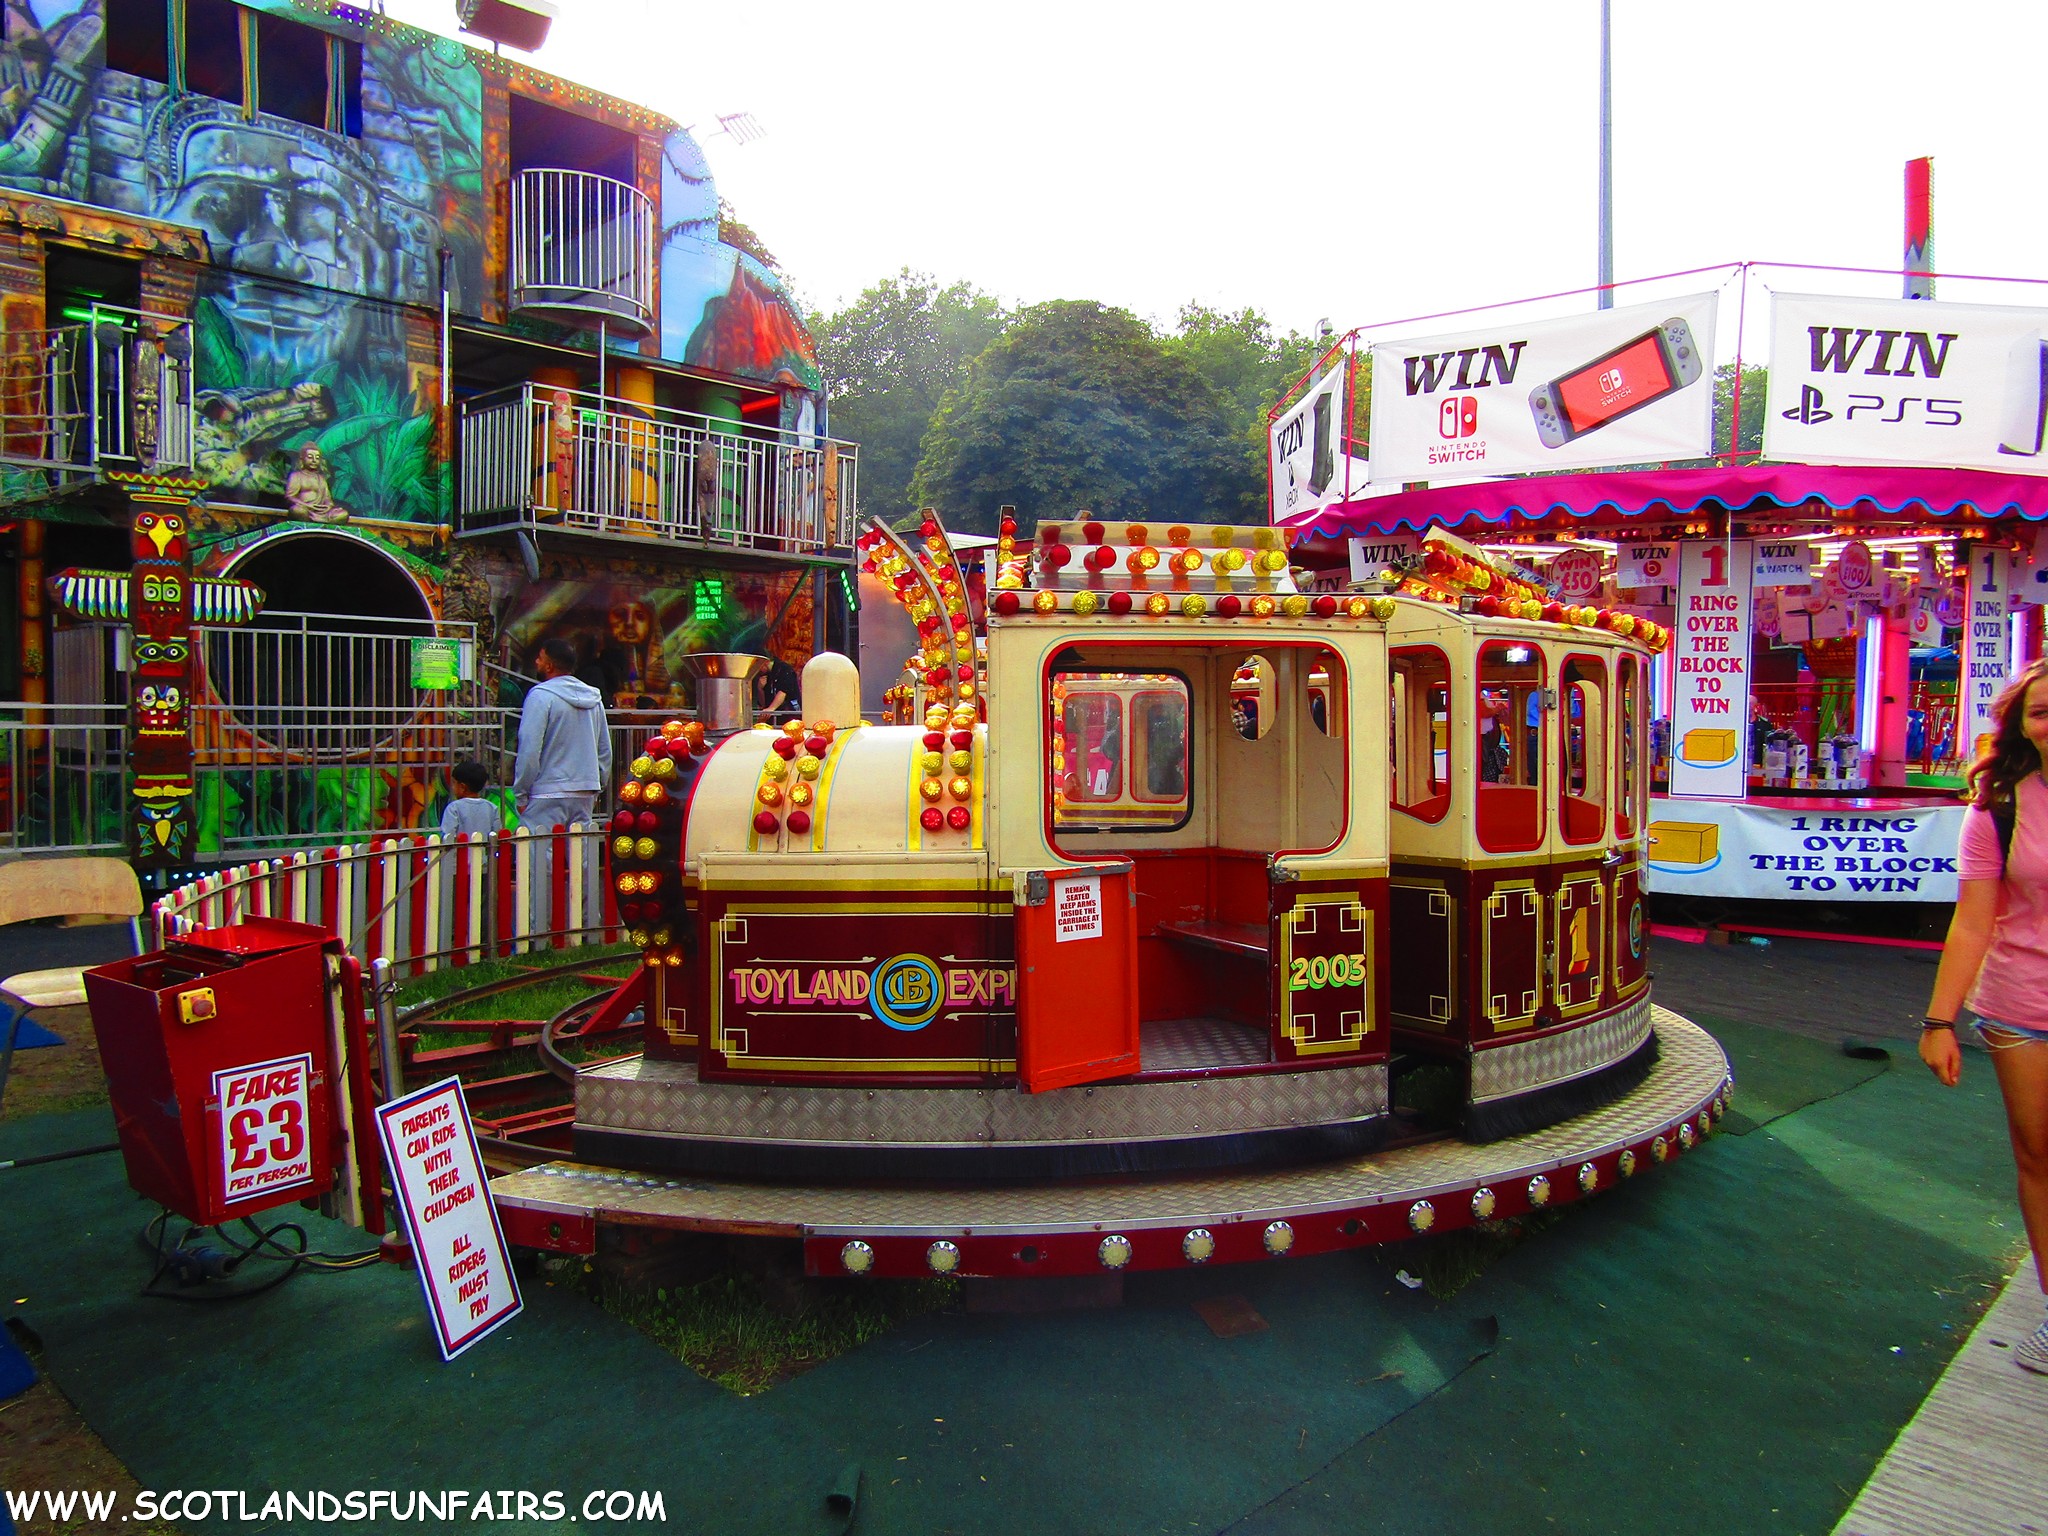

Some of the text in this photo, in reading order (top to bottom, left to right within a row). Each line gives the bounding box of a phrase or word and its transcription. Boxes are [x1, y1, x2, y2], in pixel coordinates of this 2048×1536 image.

[1807, 327, 1958, 378] WIN
[1403, 341, 1527, 396] WIN
[1601, 388, 1632, 407] SWITCH
[1847, 394, 1963, 426] PS5
[1278, 413, 1304, 464] WIN
[1428, 441, 1487, 452] NINTENDO
[1428, 450, 1486, 464] SWITCH
[1362, 544, 1407, 564] WIN
[1632, 547, 1671, 560] WIN
[1760, 545, 1797, 558] WIN
[1558, 557, 1591, 572] WIN
[1701, 546, 1730, 587] 1
[1767, 565, 1802, 573] WATCH
[1982, 552, 1998, 592] 1
[1561, 571, 1592, 591] £50
[1689, 595, 1738, 612] RING
[1975, 601, 2001, 617] RING
[1687, 616, 1739, 633] OVER
[1974, 622, 2001, 638] OVER
[1691, 637, 1729, 653] THE
[1976, 642, 1996, 658] THE
[1679, 657, 1743, 674] BLOCK
[1970, 662, 2004, 679] BLOCK
[1696, 677, 1721, 693] TO
[1979, 683, 1993, 698] TO
[1690, 698, 1731, 714] WIN
[1790, 817, 1918, 832] 1 RING
[1803, 836, 1908, 852] OVER
[1749, 854, 1958, 873] THE BLOCK
[1065, 885, 1091, 894] REMAIN
[1786, 876, 1921, 892] TO WIN
[1060, 900, 1097, 910] KEEP ARMS
[1066, 893, 1090, 901] SEATED
[1058, 916, 1091, 926] CARRIAGE
[1061, 909, 1083, 917] INSIDE
[1063, 922, 1096, 933] ALL TIMES
[1568, 906, 1590, 975] 1
[1289, 953, 1366, 992] 2003
[729, 968, 870, 1006] TOYLAND
[226, 1066, 302, 1108] FARE
[401, 1103, 451, 1138] PARENTS
[229, 1100, 305, 1173] £3
[407, 1122, 457, 1159] CAN RIDE
[424, 1148, 453, 1175] WITH
[229, 1162, 308, 1192] PER PERSON
[427, 1167, 460, 1197] THEIR
[423, 1183, 475, 1224] CHILDREN
[453, 1233, 472, 1258] ALL
[448, 1248, 487, 1284] RIDERS
[458, 1269, 489, 1304] MUST
[470, 1294, 490, 1321] PAY
